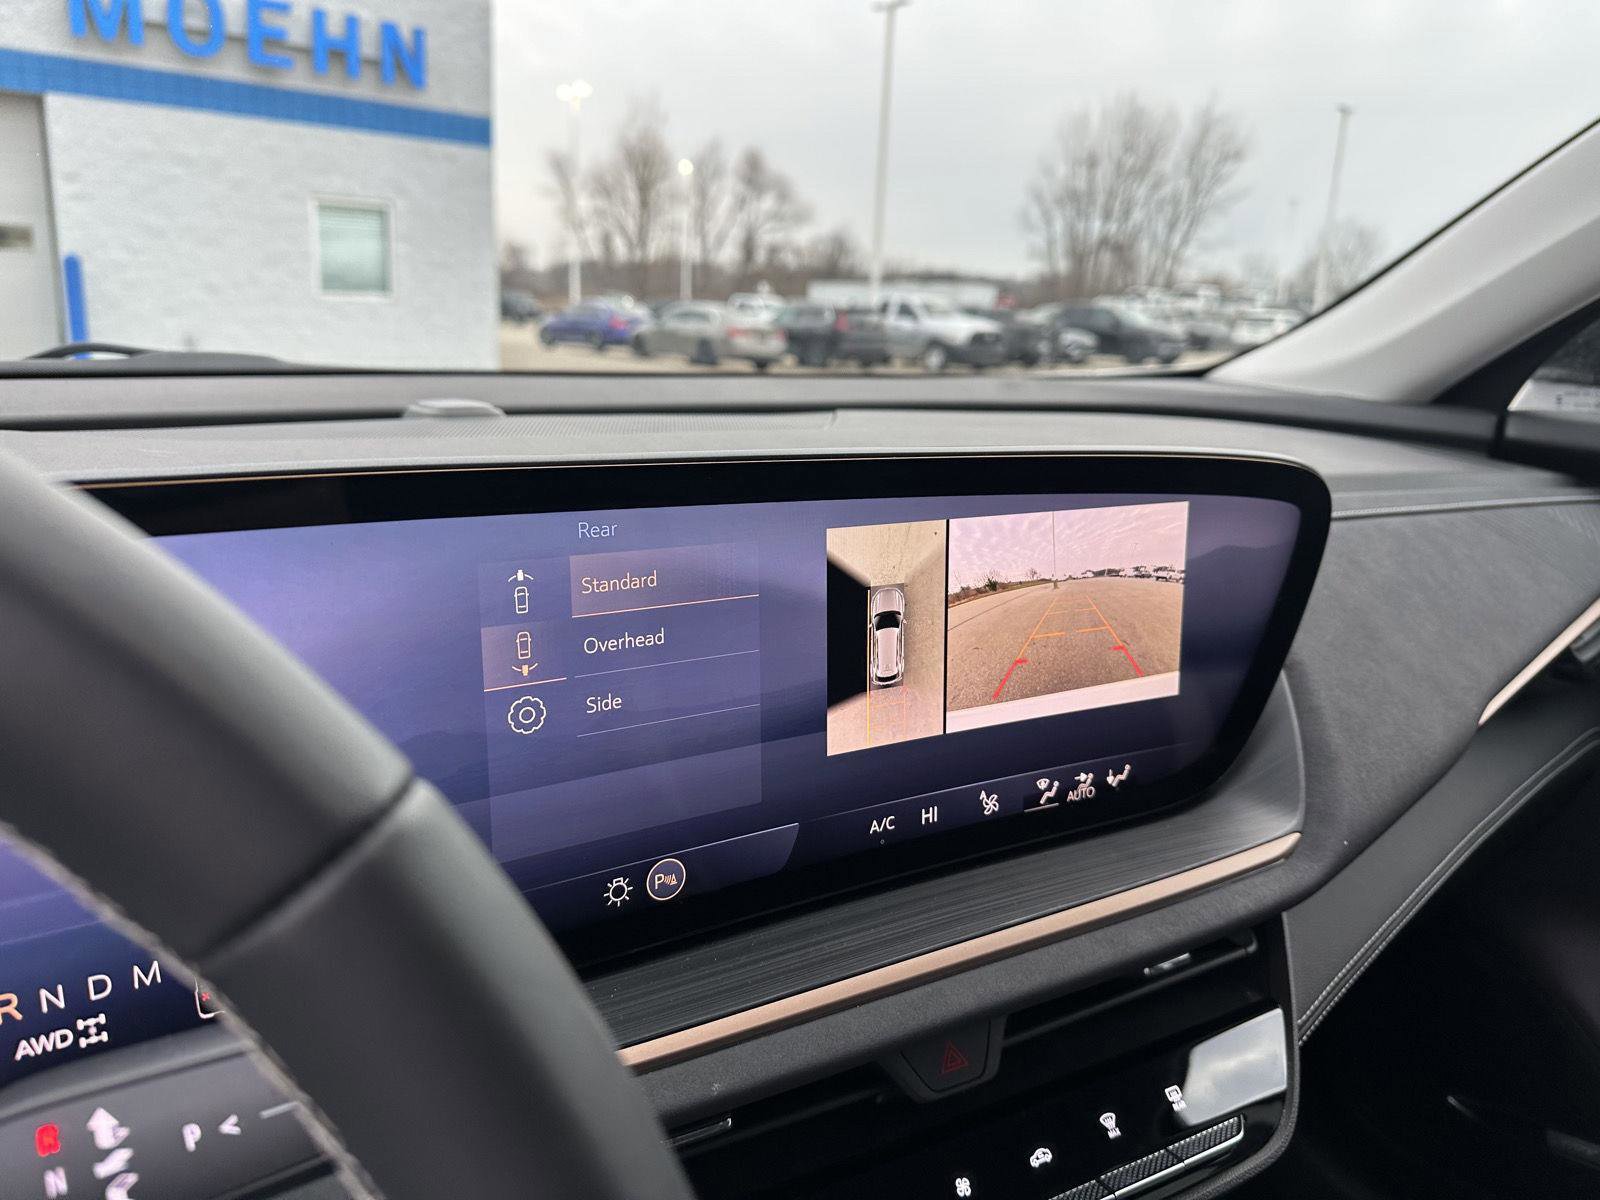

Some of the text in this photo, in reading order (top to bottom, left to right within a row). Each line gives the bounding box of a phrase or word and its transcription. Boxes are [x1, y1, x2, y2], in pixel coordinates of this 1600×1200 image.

[69, 0, 428, 90] MOEHN
[578, 521, 618, 539] Rear
[581, 570, 658, 594] Standard
[583, 627, 665, 654] Overhead
[586, 693, 623, 713] Side
[1066, 786, 1096, 803] AUTO
[869, 815, 895, 834] A/C
[921, 805, 938, 825] HI
[0, 960, 162, 1026] R N D M
[14, 1028, 74, 1062] AWD
